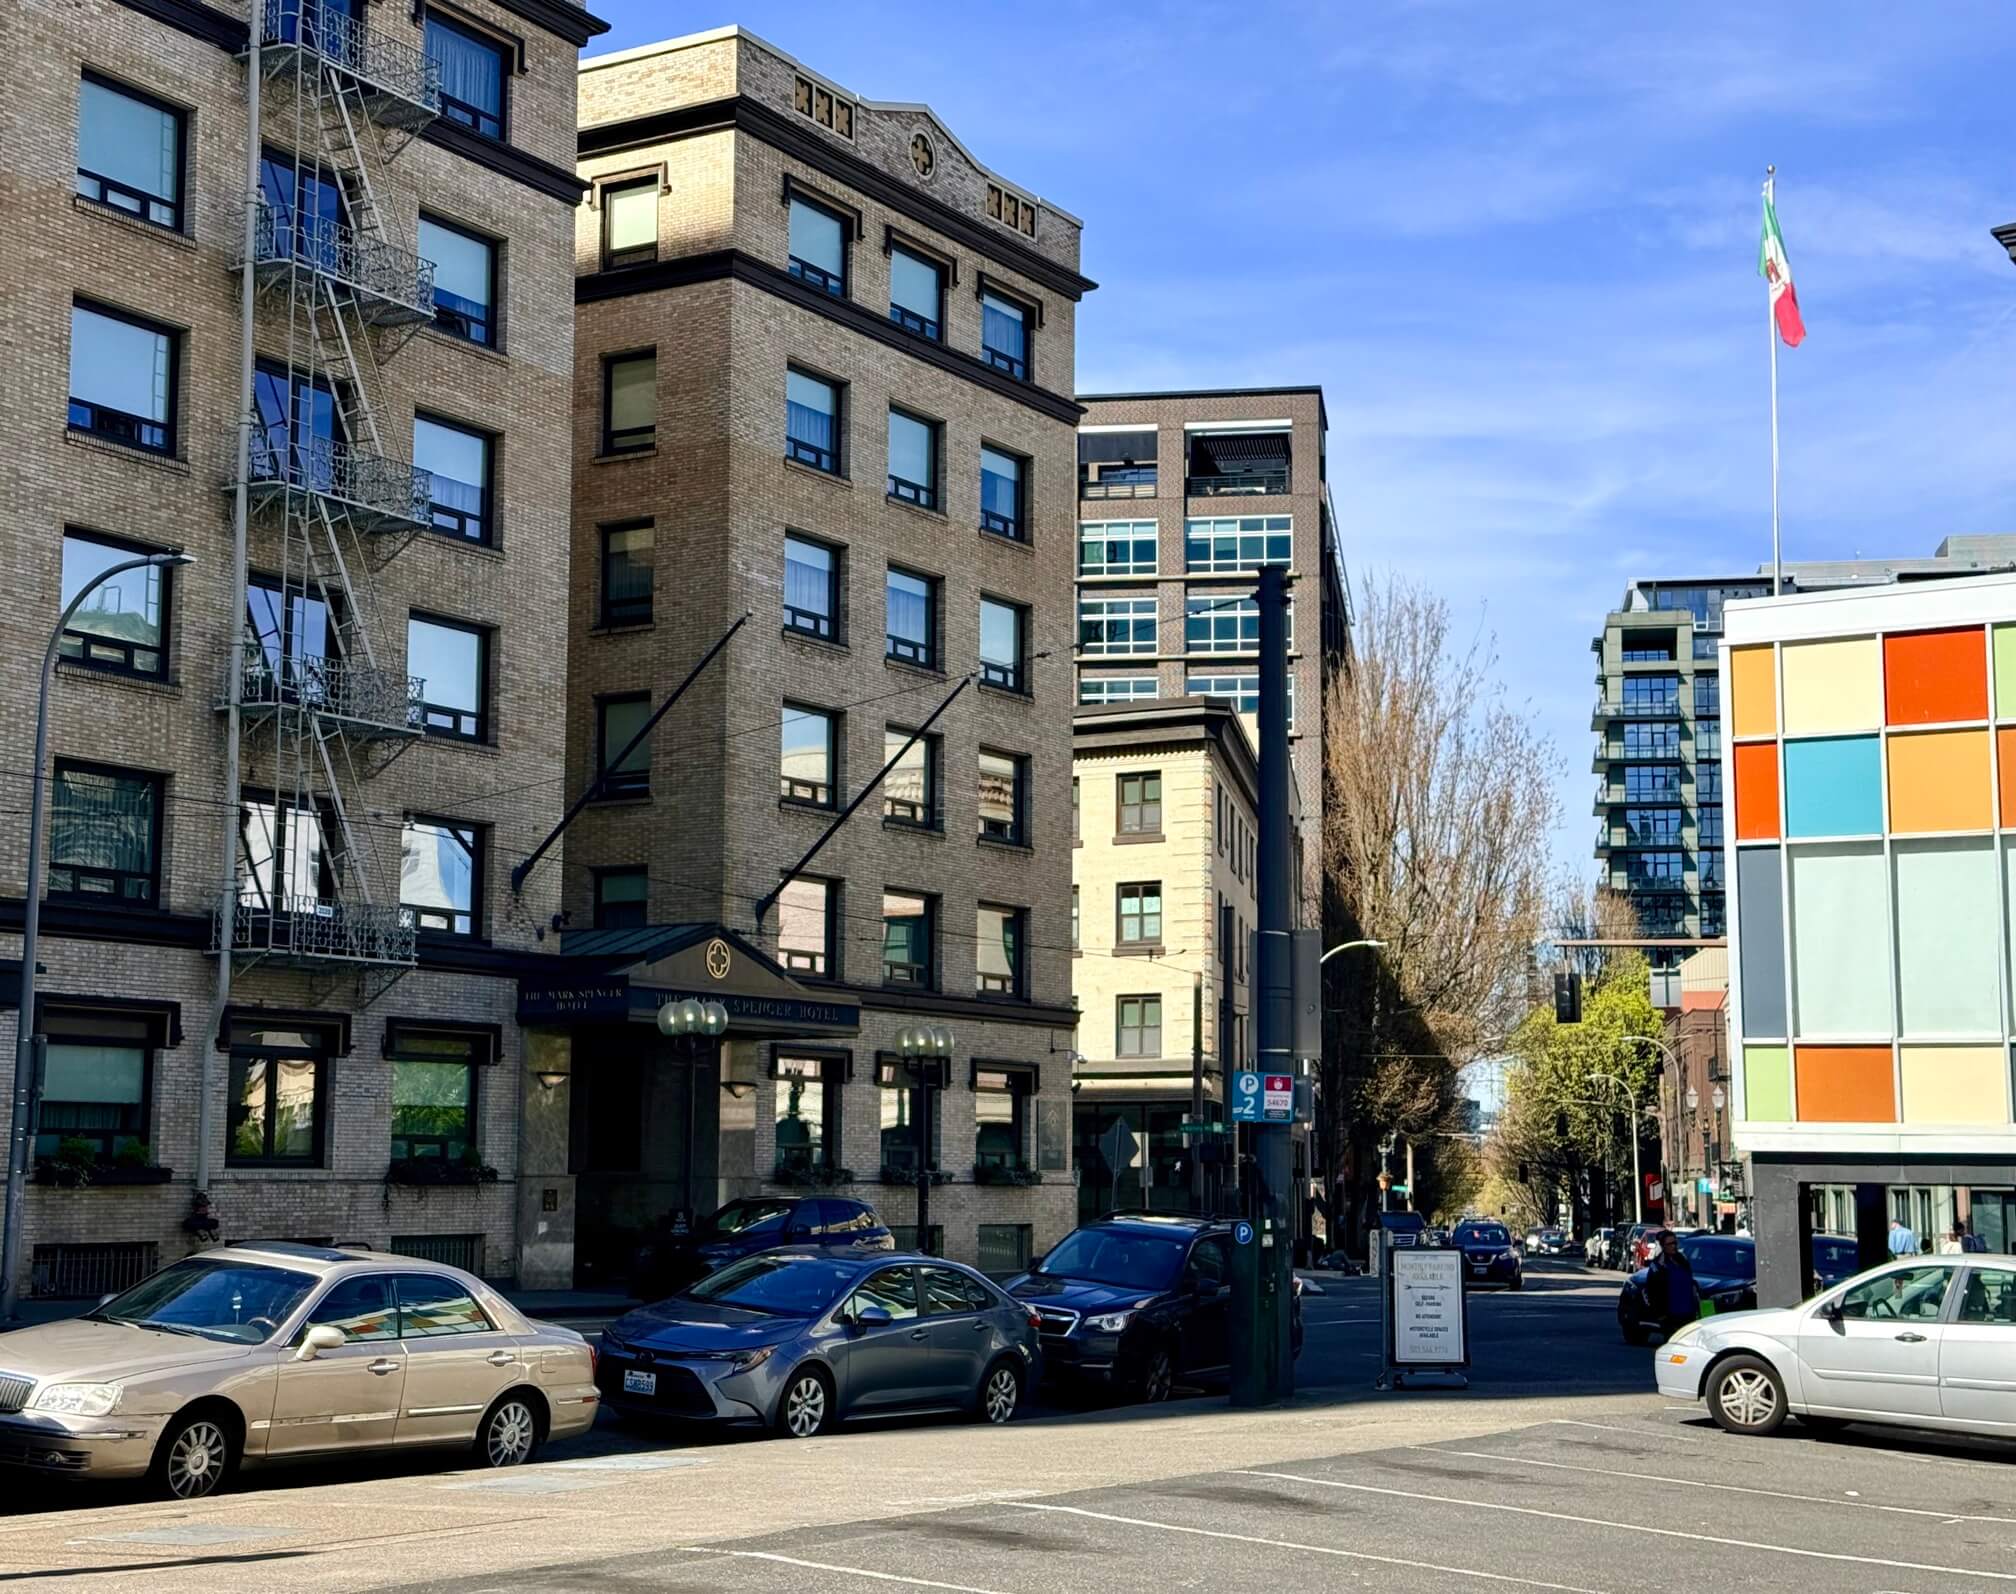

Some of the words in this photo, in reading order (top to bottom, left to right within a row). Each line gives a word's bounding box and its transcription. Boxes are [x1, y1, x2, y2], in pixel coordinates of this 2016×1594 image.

[547, 990, 575, 1000] MARK
[734, 999, 792, 1017] SPENCER
[800, 1006, 839, 1022] HOTEL
[1243, 1096, 1255, 1114] 2
